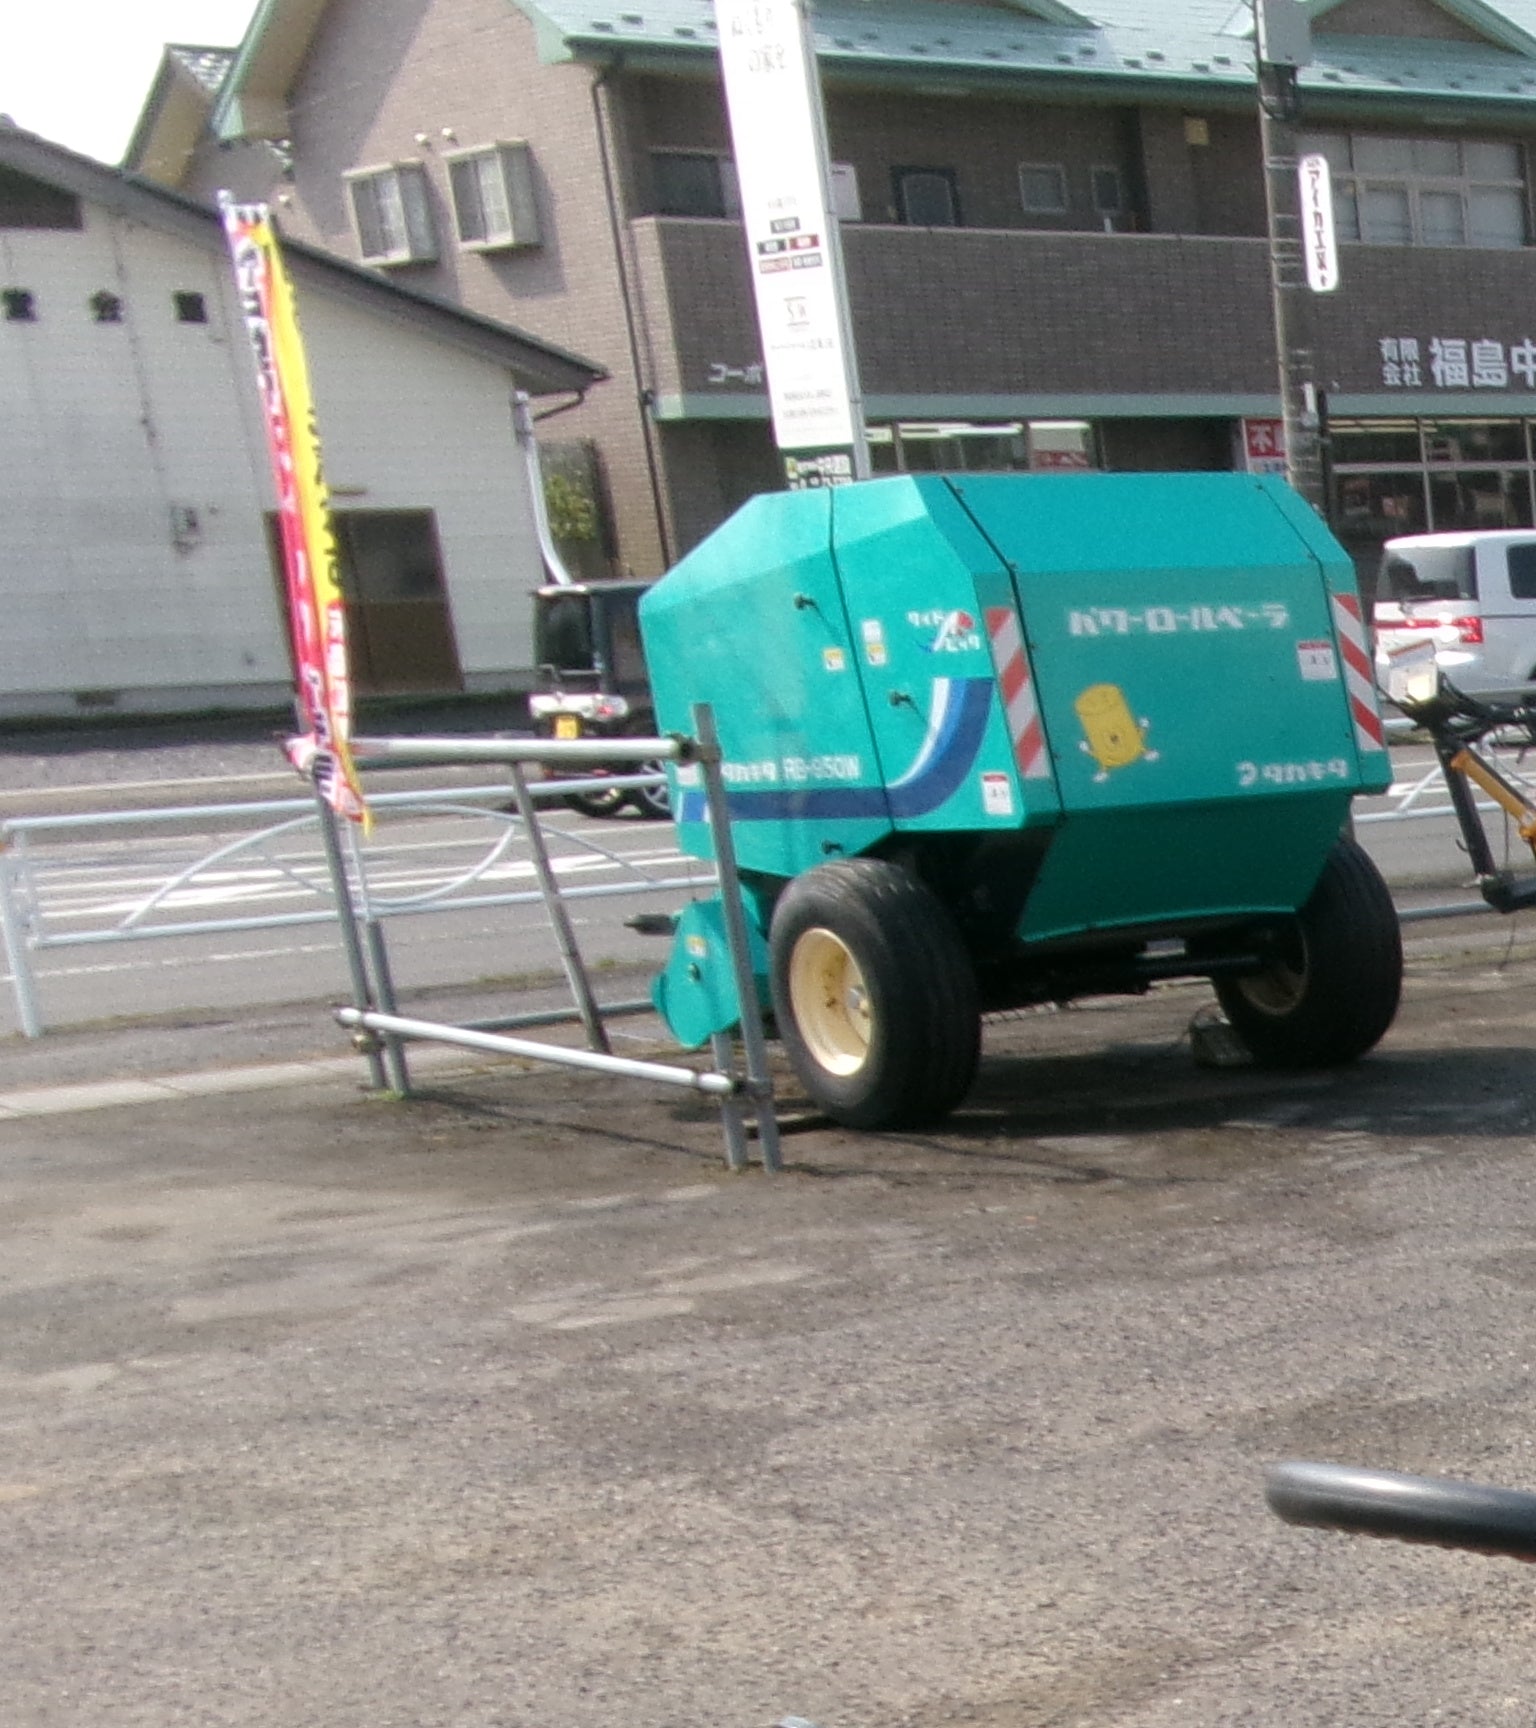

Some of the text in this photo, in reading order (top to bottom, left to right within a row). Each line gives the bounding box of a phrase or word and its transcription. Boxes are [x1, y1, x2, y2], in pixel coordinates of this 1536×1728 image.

[1069, 603, 1290, 636] パワーロールベーラ
